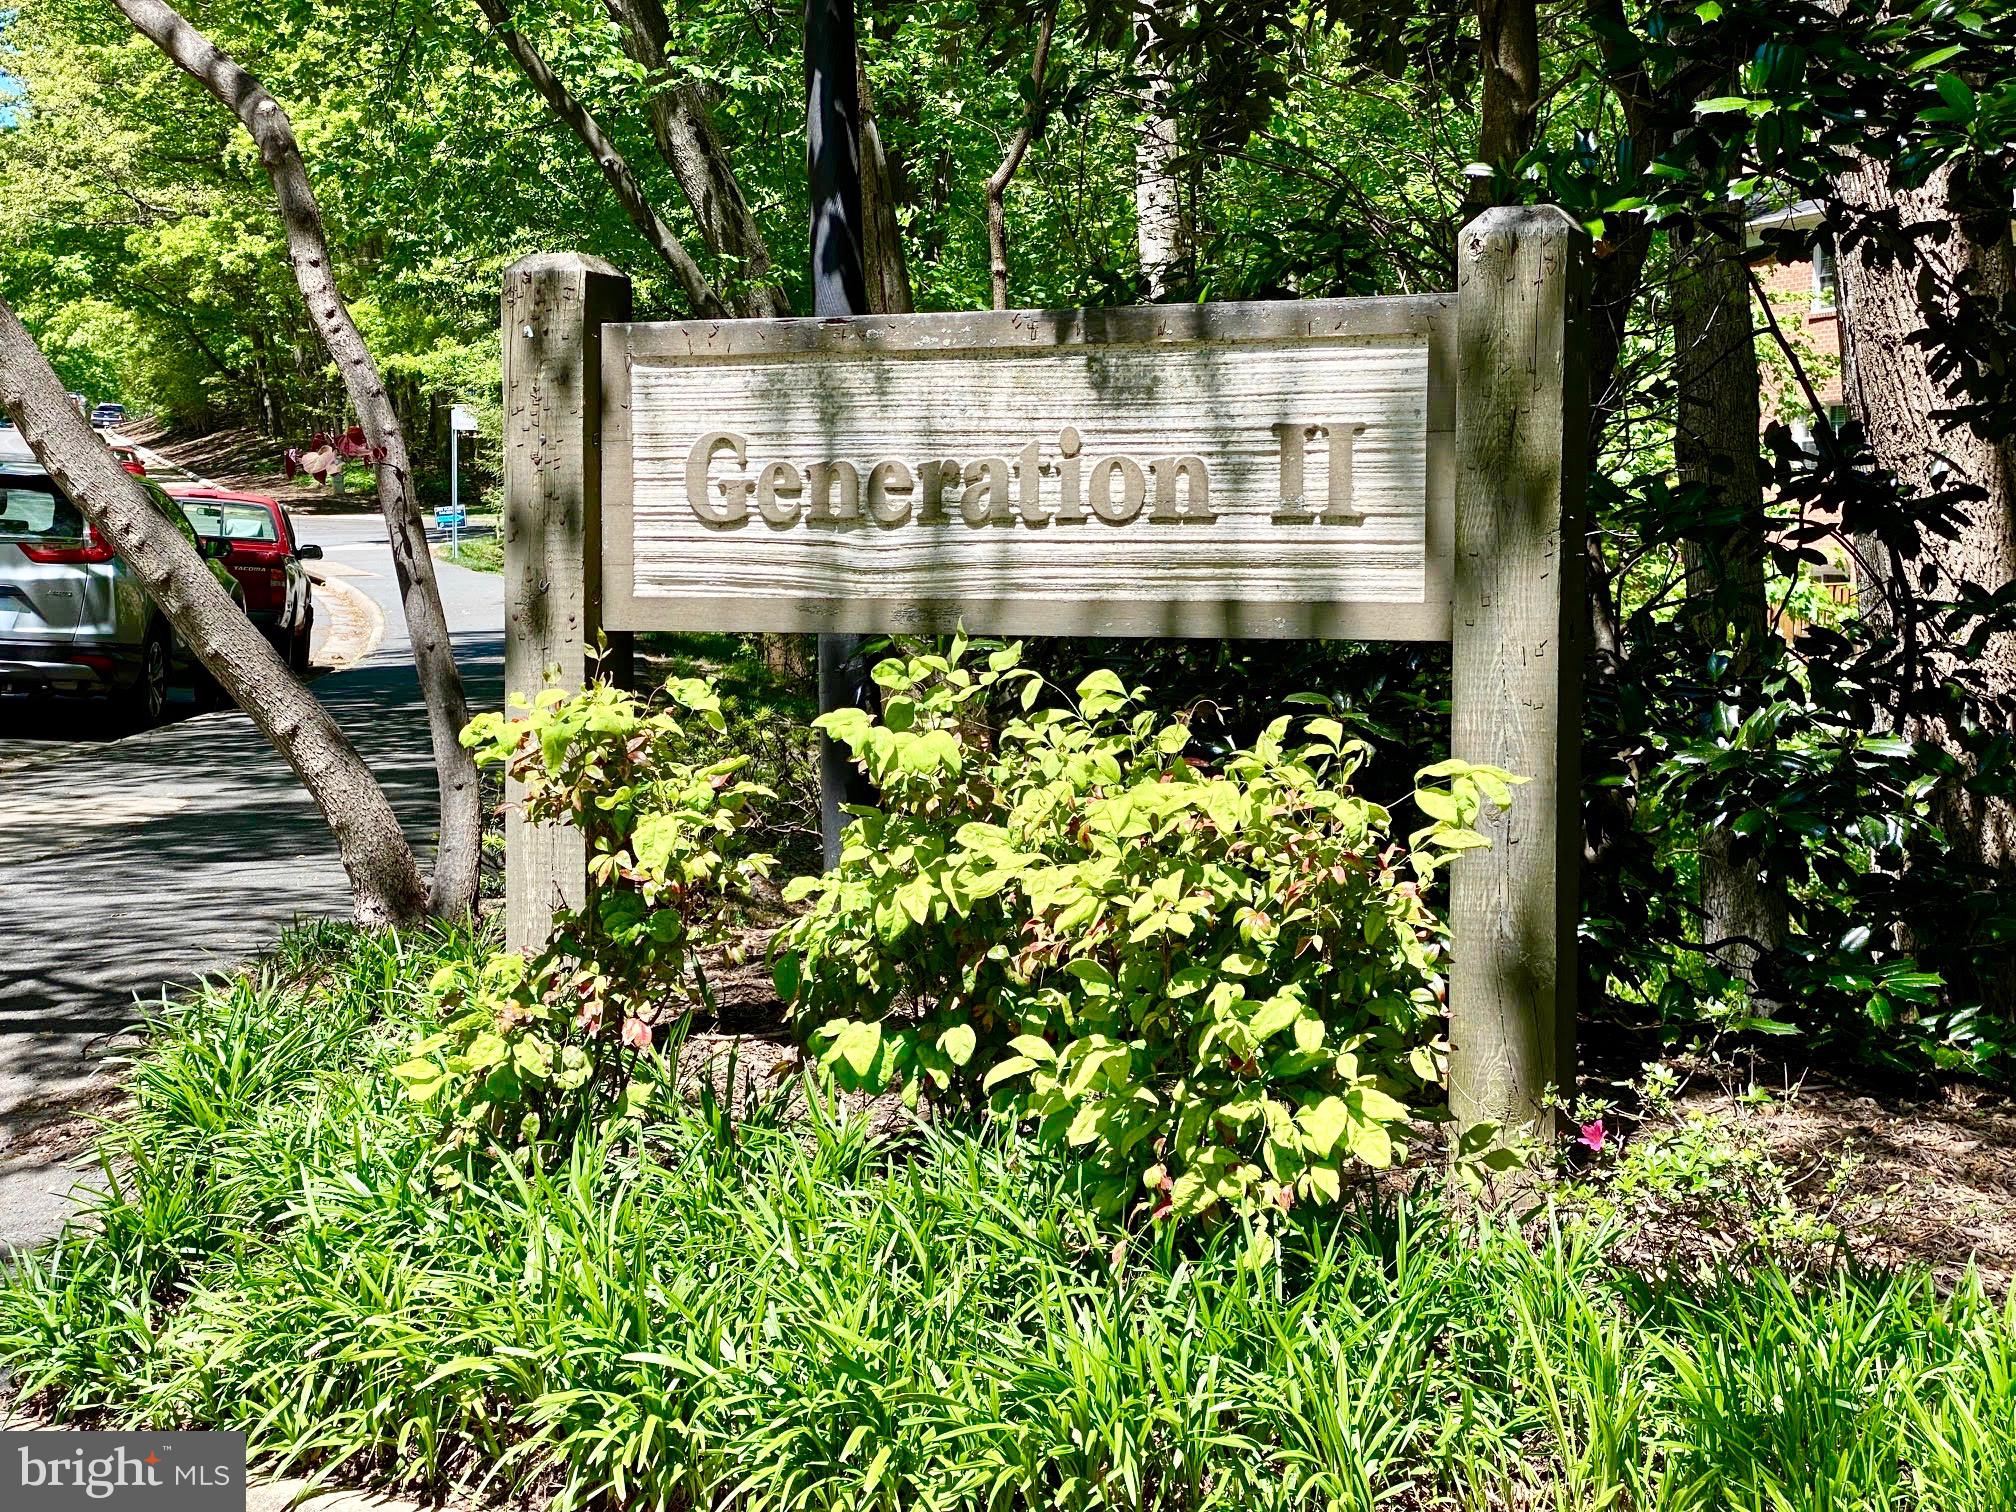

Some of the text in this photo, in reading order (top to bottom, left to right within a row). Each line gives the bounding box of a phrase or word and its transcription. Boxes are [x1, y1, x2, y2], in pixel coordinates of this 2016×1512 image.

[685, 422, 1366, 531] Generation II
[233, 565, 266, 573] TACOMA
